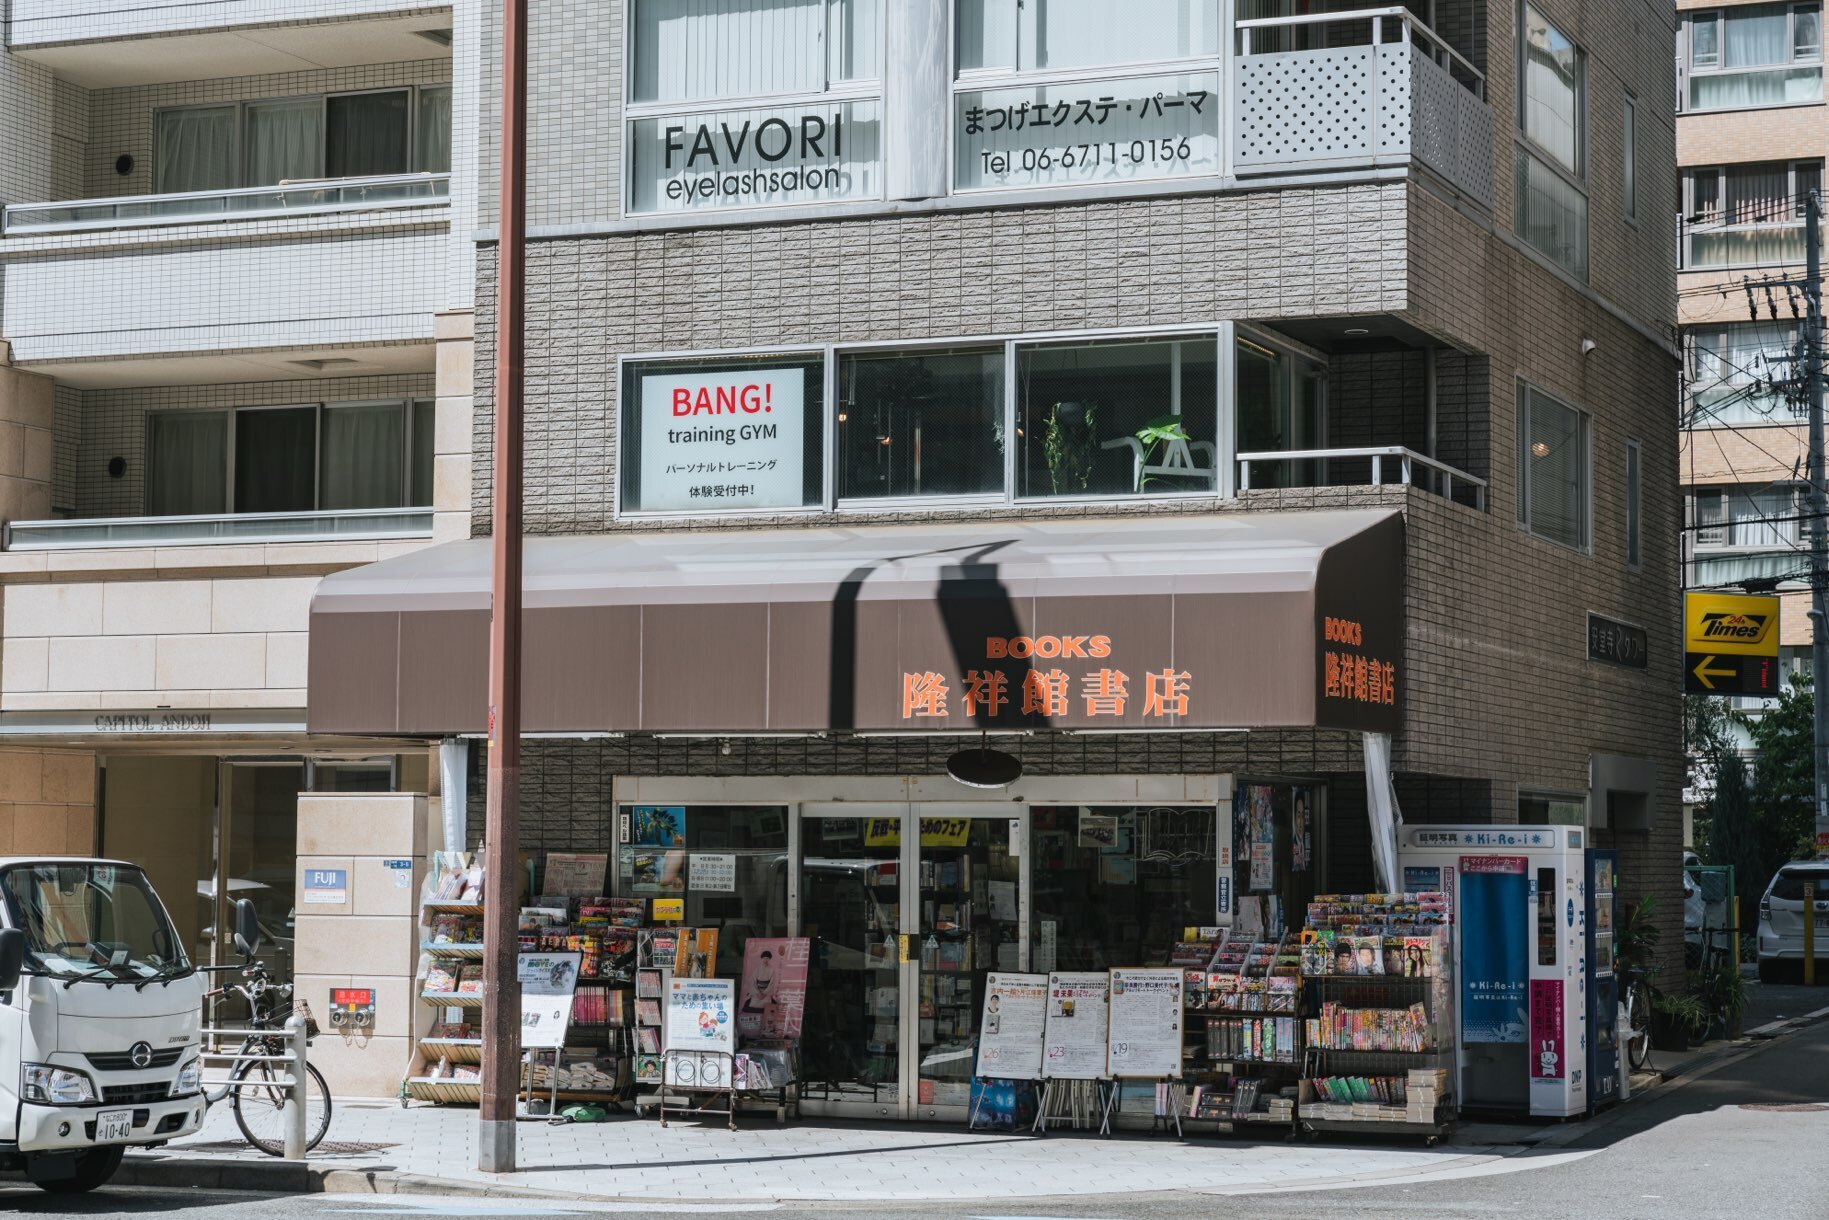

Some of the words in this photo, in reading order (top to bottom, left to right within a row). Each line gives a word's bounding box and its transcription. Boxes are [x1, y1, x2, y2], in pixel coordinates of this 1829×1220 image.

[965, 90, 1208, 136] まつげエクステ・パーマ
[665, 113, 842, 169] FAVORI
[981, 151, 1010, 174] Tel
[1022, 137, 1191, 171] 06-6711-0156
[665, 164, 840, 204] eyelashsalon
[672, 383, 772, 417] BANG!
[668, 425, 736, 445] training
[740, 424, 777, 440] GYM
[666, 459, 778, 474] パーソナルトレーニング
[1325, 616, 1361, 646] BOOKS
[1703, 619, 1760, 638] Times
[986, 635, 1112, 659] BOOKS
[1325, 651, 1395, 706] 隆祥館書店
[902, 668, 1192, 719] 隆祥館書店
[95, 714, 154, 731] CAPITOL
[1420, 833, 1457, 842] 証明写真
[1477, 833, 1528, 845] Ki-Re-i
[314, 871, 336, 884] FUJI
[672, 993, 728, 1002] ママと赤ちゃんの
[1571, 1069, 1582, 1084] DNP
